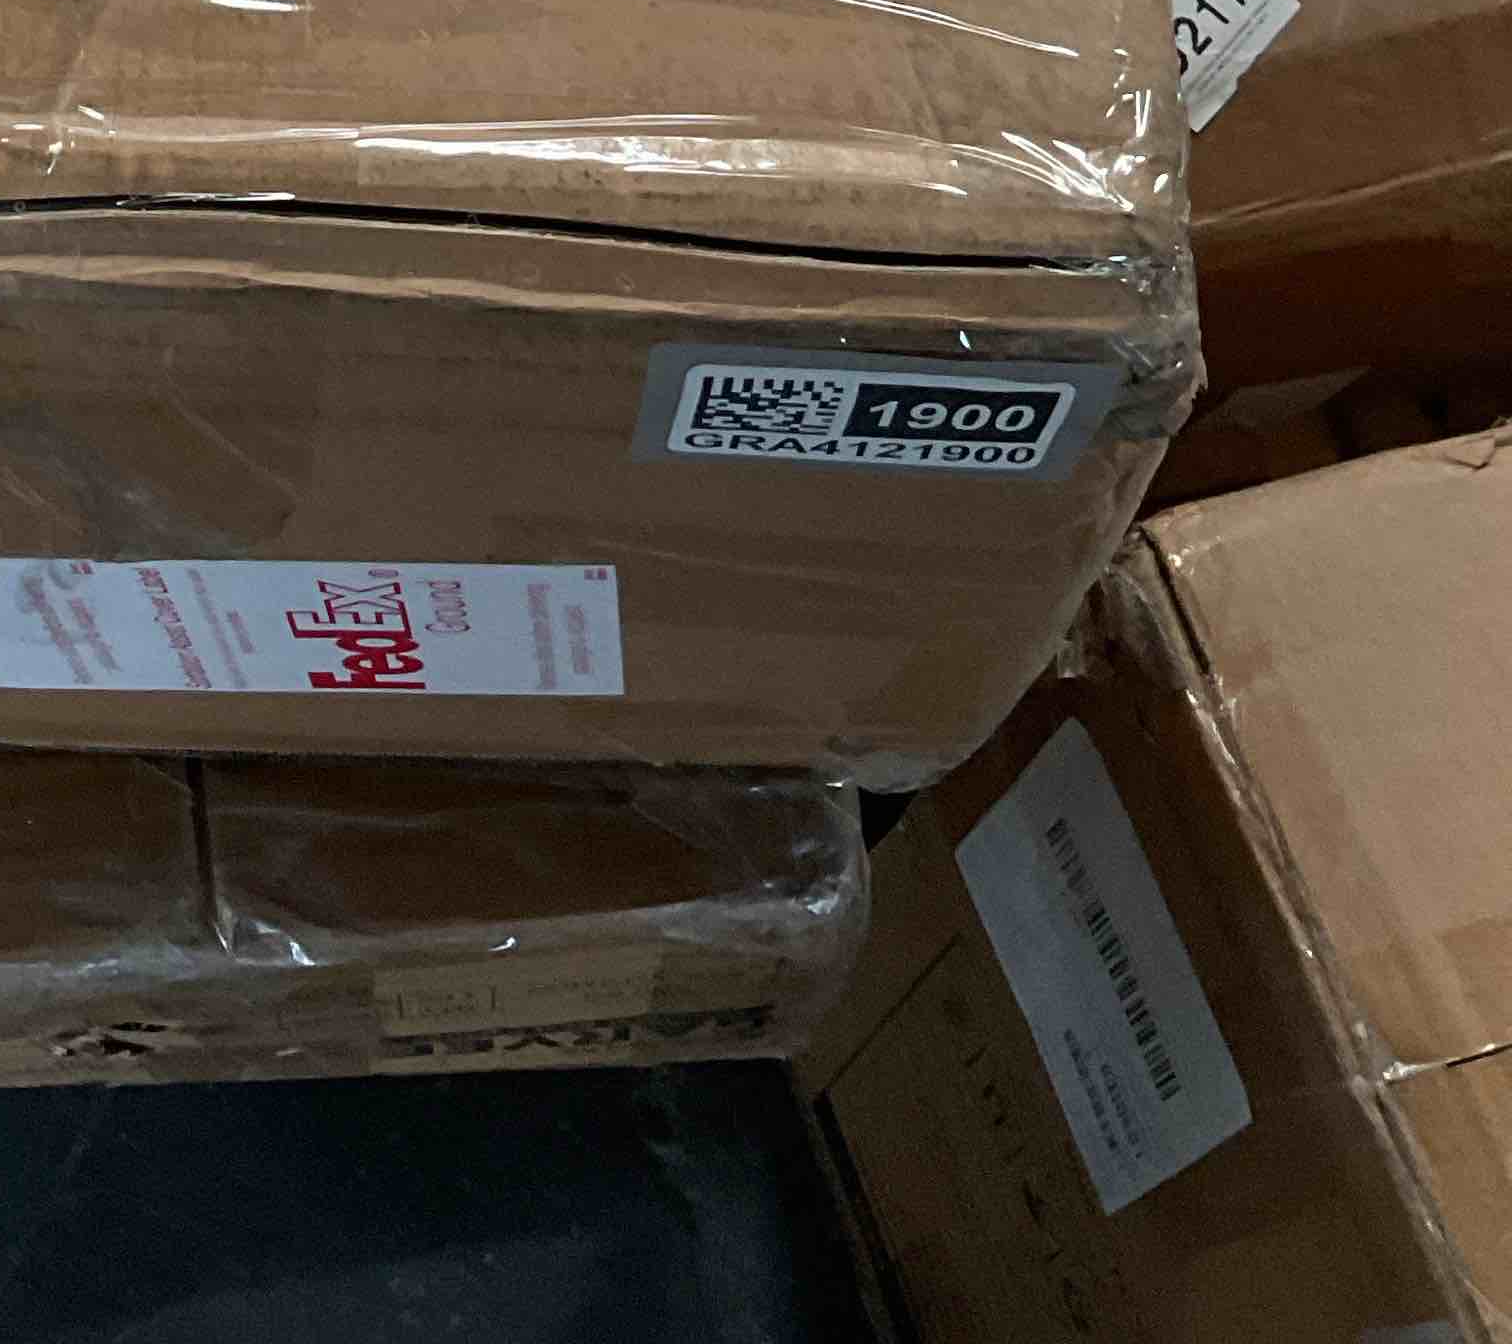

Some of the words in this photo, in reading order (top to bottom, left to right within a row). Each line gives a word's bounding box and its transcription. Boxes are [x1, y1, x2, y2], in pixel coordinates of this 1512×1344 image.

[868, 398, 1037, 434] 1900
[684, 432, 1037, 466] GRA4121900
[285, 577, 427, 690] FedEx
